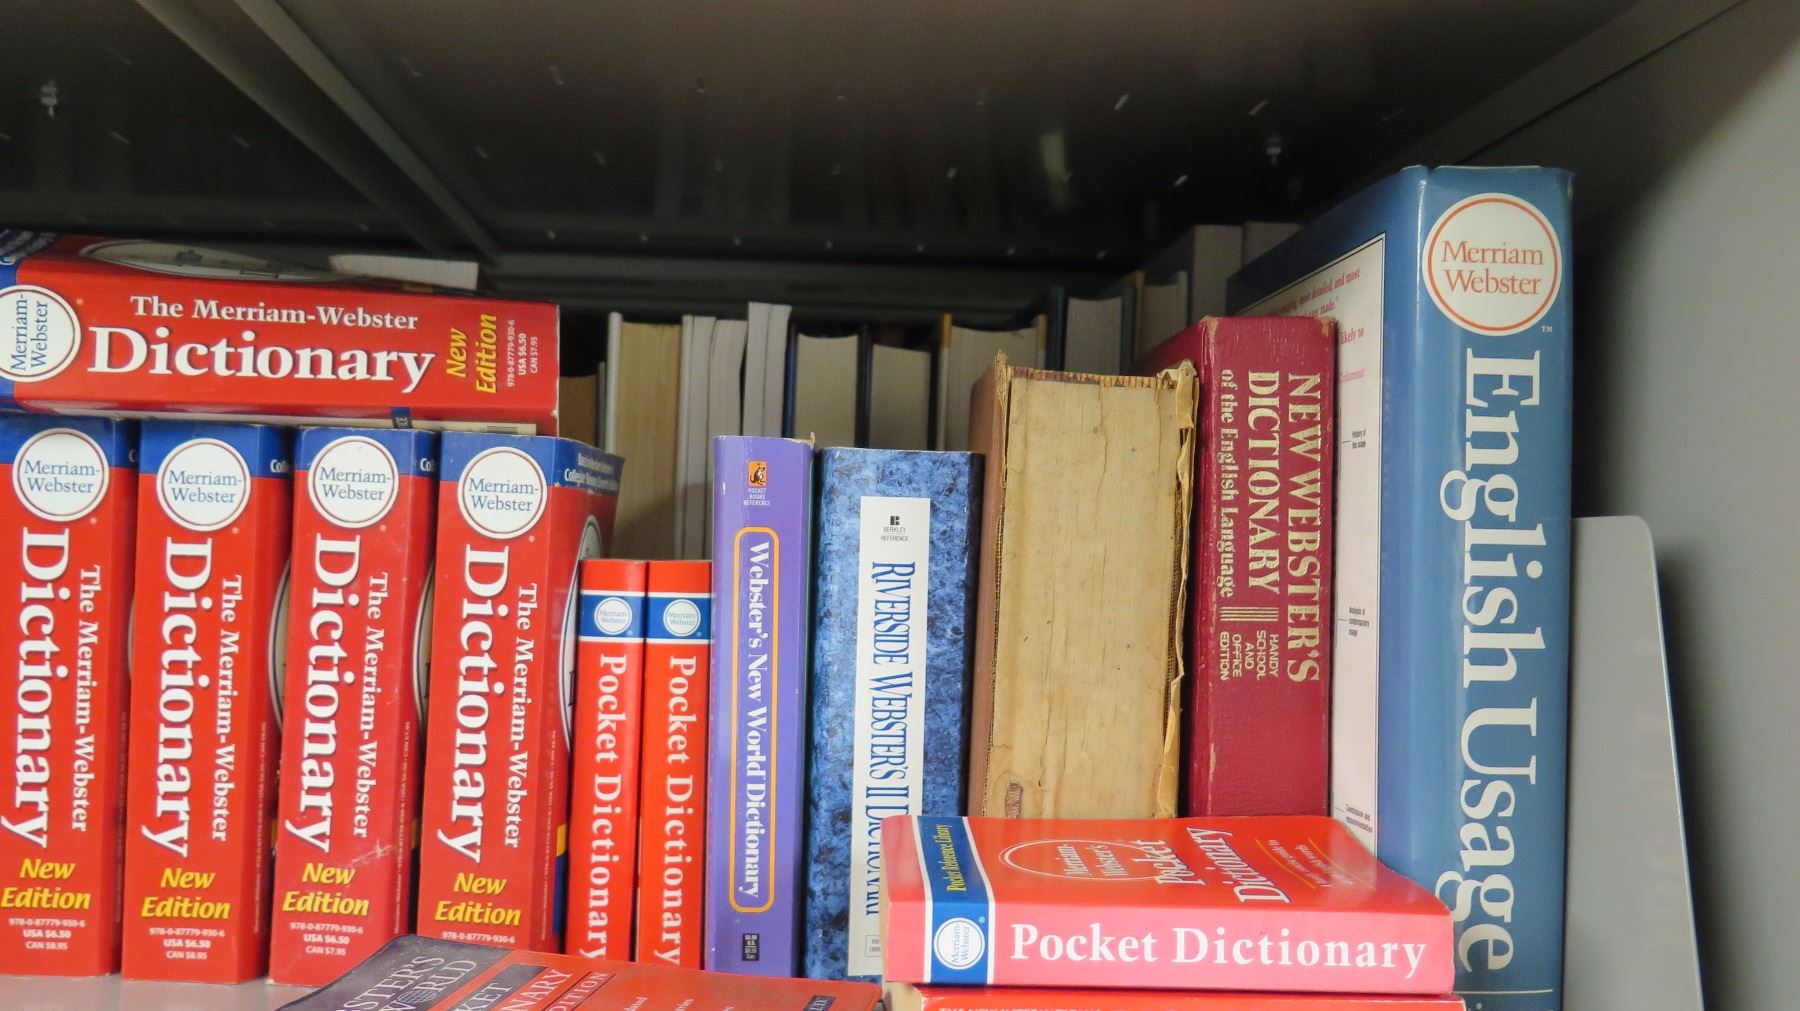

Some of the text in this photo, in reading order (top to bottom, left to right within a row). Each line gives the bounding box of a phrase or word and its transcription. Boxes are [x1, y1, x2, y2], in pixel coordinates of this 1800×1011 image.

[1441, 240, 1545, 266] Merriam
[1443, 269, 1542, 296] Webster
[10, 293, 30, 371] Merriam-
[30, 300, 49, 368] Webster
[130, 295, 419, 330] The Merriam-Webster
[87, 326, 436, 393] Dictionary
[446, 327, 468, 378] New
[476, 314, 497, 394] Edition
[518, 333, 527, 375] USA $6.50
[530, 357, 538, 374] CAN
[24, 460, 101, 476] Merriam-
[27, 477, 95, 494] Webster
[168, 470, 242, 487] Merriam-
[319, 466, 391, 484] Merriam-
[468, 477, 539, 495] Merriam-
[1216, 369, 1239, 598] of the English Language
[1247, 370, 1281, 595] DICTIONARY
[171, 488, 236, 504] Webster
[321, 484, 385, 501] Webster
[470, 494, 533, 513] Webster
[1287, 373, 1322, 682] NEW WEBSTER'S
[872, 561, 916, 665] RIVERSIDE
[1219, 631, 1230, 681] EDITION
[1231, 633, 1242, 678] OFFICE
[1245, 642, 1255, 670] AND
[1256, 630, 1267, 681] SCHOOL
[1269, 634, 1279, 678] HANDY
[1435, 347, 1547, 973] English Usage
[0, 527, 71, 848] Dictionary
[72, 564, 101, 832] The Merriam-Webster
[141, 536, 213, 858] Dictionary
[212, 574, 243, 842] The Merriam-Webster
[284, 533, 360, 853] Dictionary
[353, 572, 388, 839] The Merriam-Webster
[436, 543, 509, 864] Dictionary
[667, 655, 698, 765] Pocket
[504, 583, 538, 848] The Merriam-Webster
[739, 541, 770, 897] Webster's New World Dictionary
[867, 671, 913, 780] WEBSTER'S
[579, 653, 628, 959] Pocket Dictionary
[866, 786, 909, 798] II
[19, 858, 76, 880] New
[160, 867, 216, 889] New
[301, 862, 356, 886] New
[453, 872, 507, 896] New
[654, 774, 694, 966] Dictionary
[1131, 838, 1207, 886] Pocket
[1186, 826, 1291, 904] Dictionary
[1, 887, 91, 910] Edition
[141, 896, 231, 920] Edition
[282, 890, 369, 917] Edition
[434, 900, 522, 926] Edition
[23, 928, 43, 938] USA
[163, 938, 183, 948] USA
[303, 933, 324, 943] USA
[1010, 922, 1428, 979] Pocket Dictionary
[343, 956, 445, 1010] STER'S
